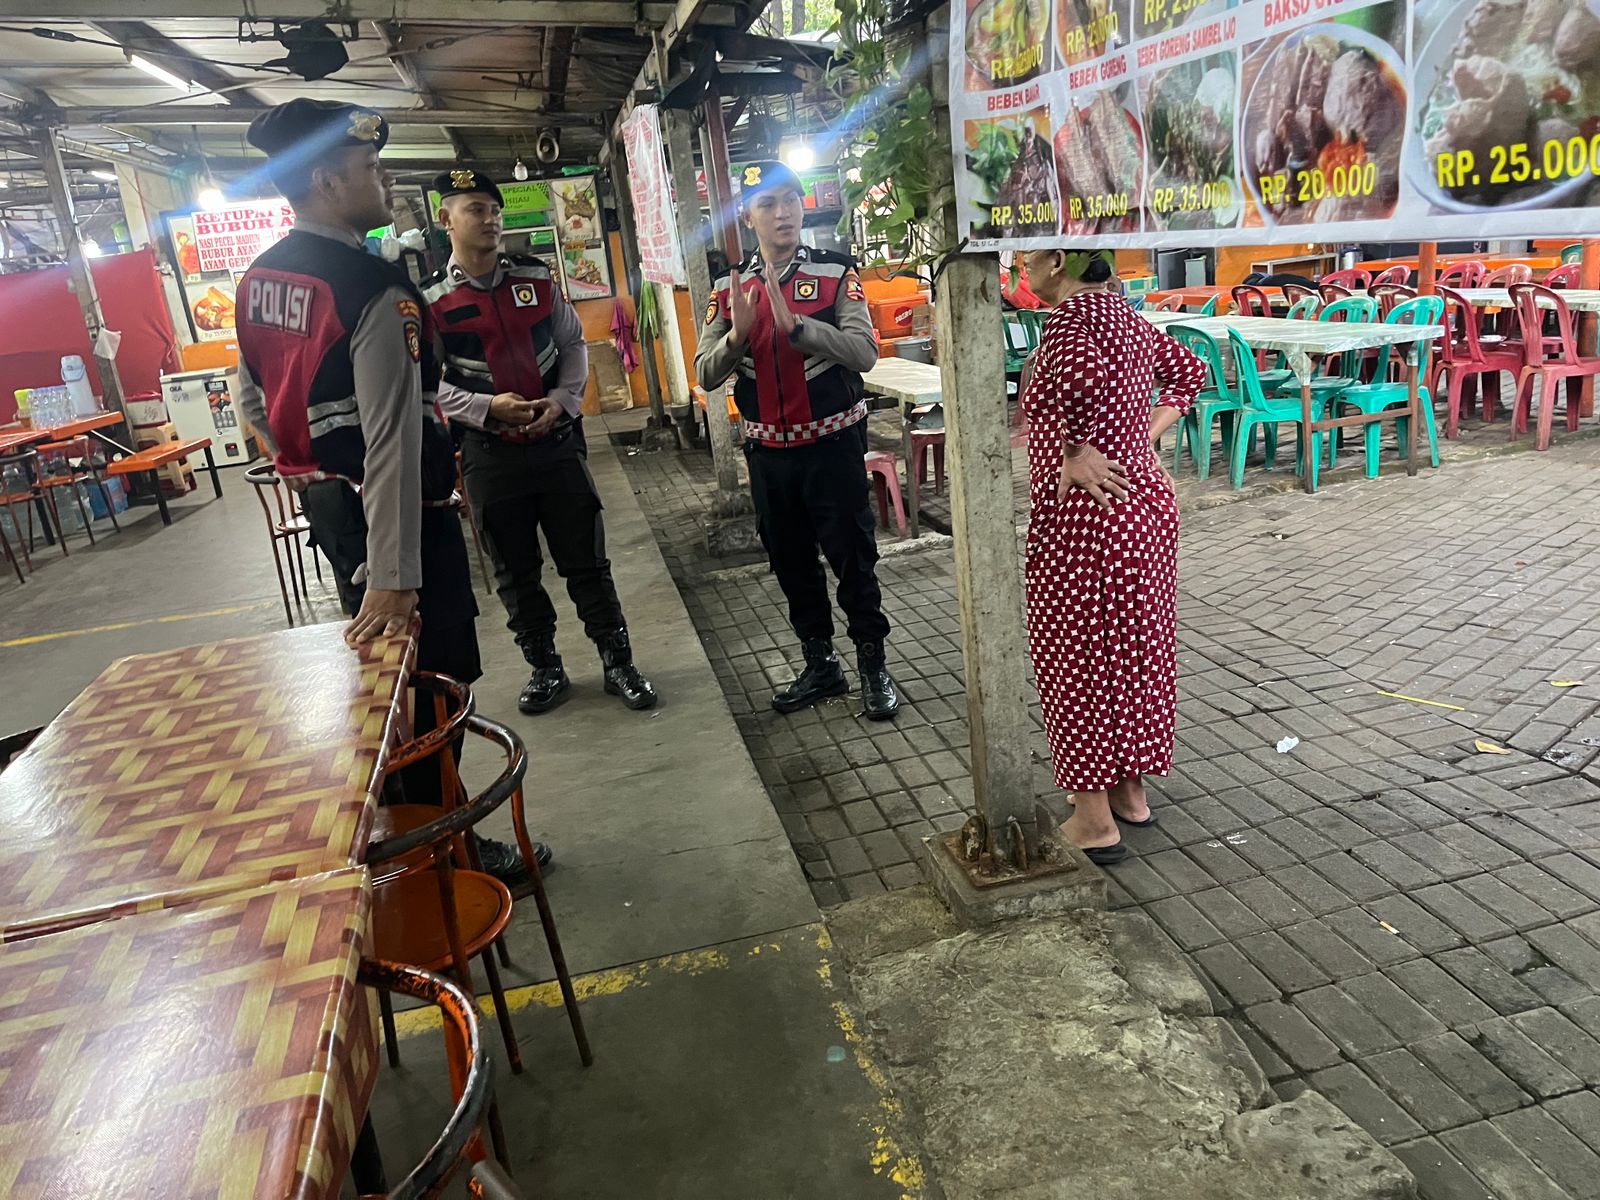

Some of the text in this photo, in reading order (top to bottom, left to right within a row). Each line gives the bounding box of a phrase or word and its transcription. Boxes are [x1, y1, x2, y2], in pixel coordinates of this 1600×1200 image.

[1144, 0, 1167, 25] RP.
[1069, 54, 1127, 90] BEBEK GORENG
[987, 92, 1024, 112] BEBEK
[1437, 150, 1481, 189] RP.
[1260, 162, 1377, 205] RP. 20.000
[1070, 193, 1128, 219] RP. 35.000
[1153, 181, 1233, 213] RP. 35.000
[280, 205, 294, 216] S
[991, 206, 1014, 226] RP.
[196, 216, 295, 236] BUBUR A
[215, 235, 235, 248] PECEL
[201, 246, 235, 260] BUBUR
[203, 259, 227, 271] AYAM
[247, 279, 311, 333] POLISI
